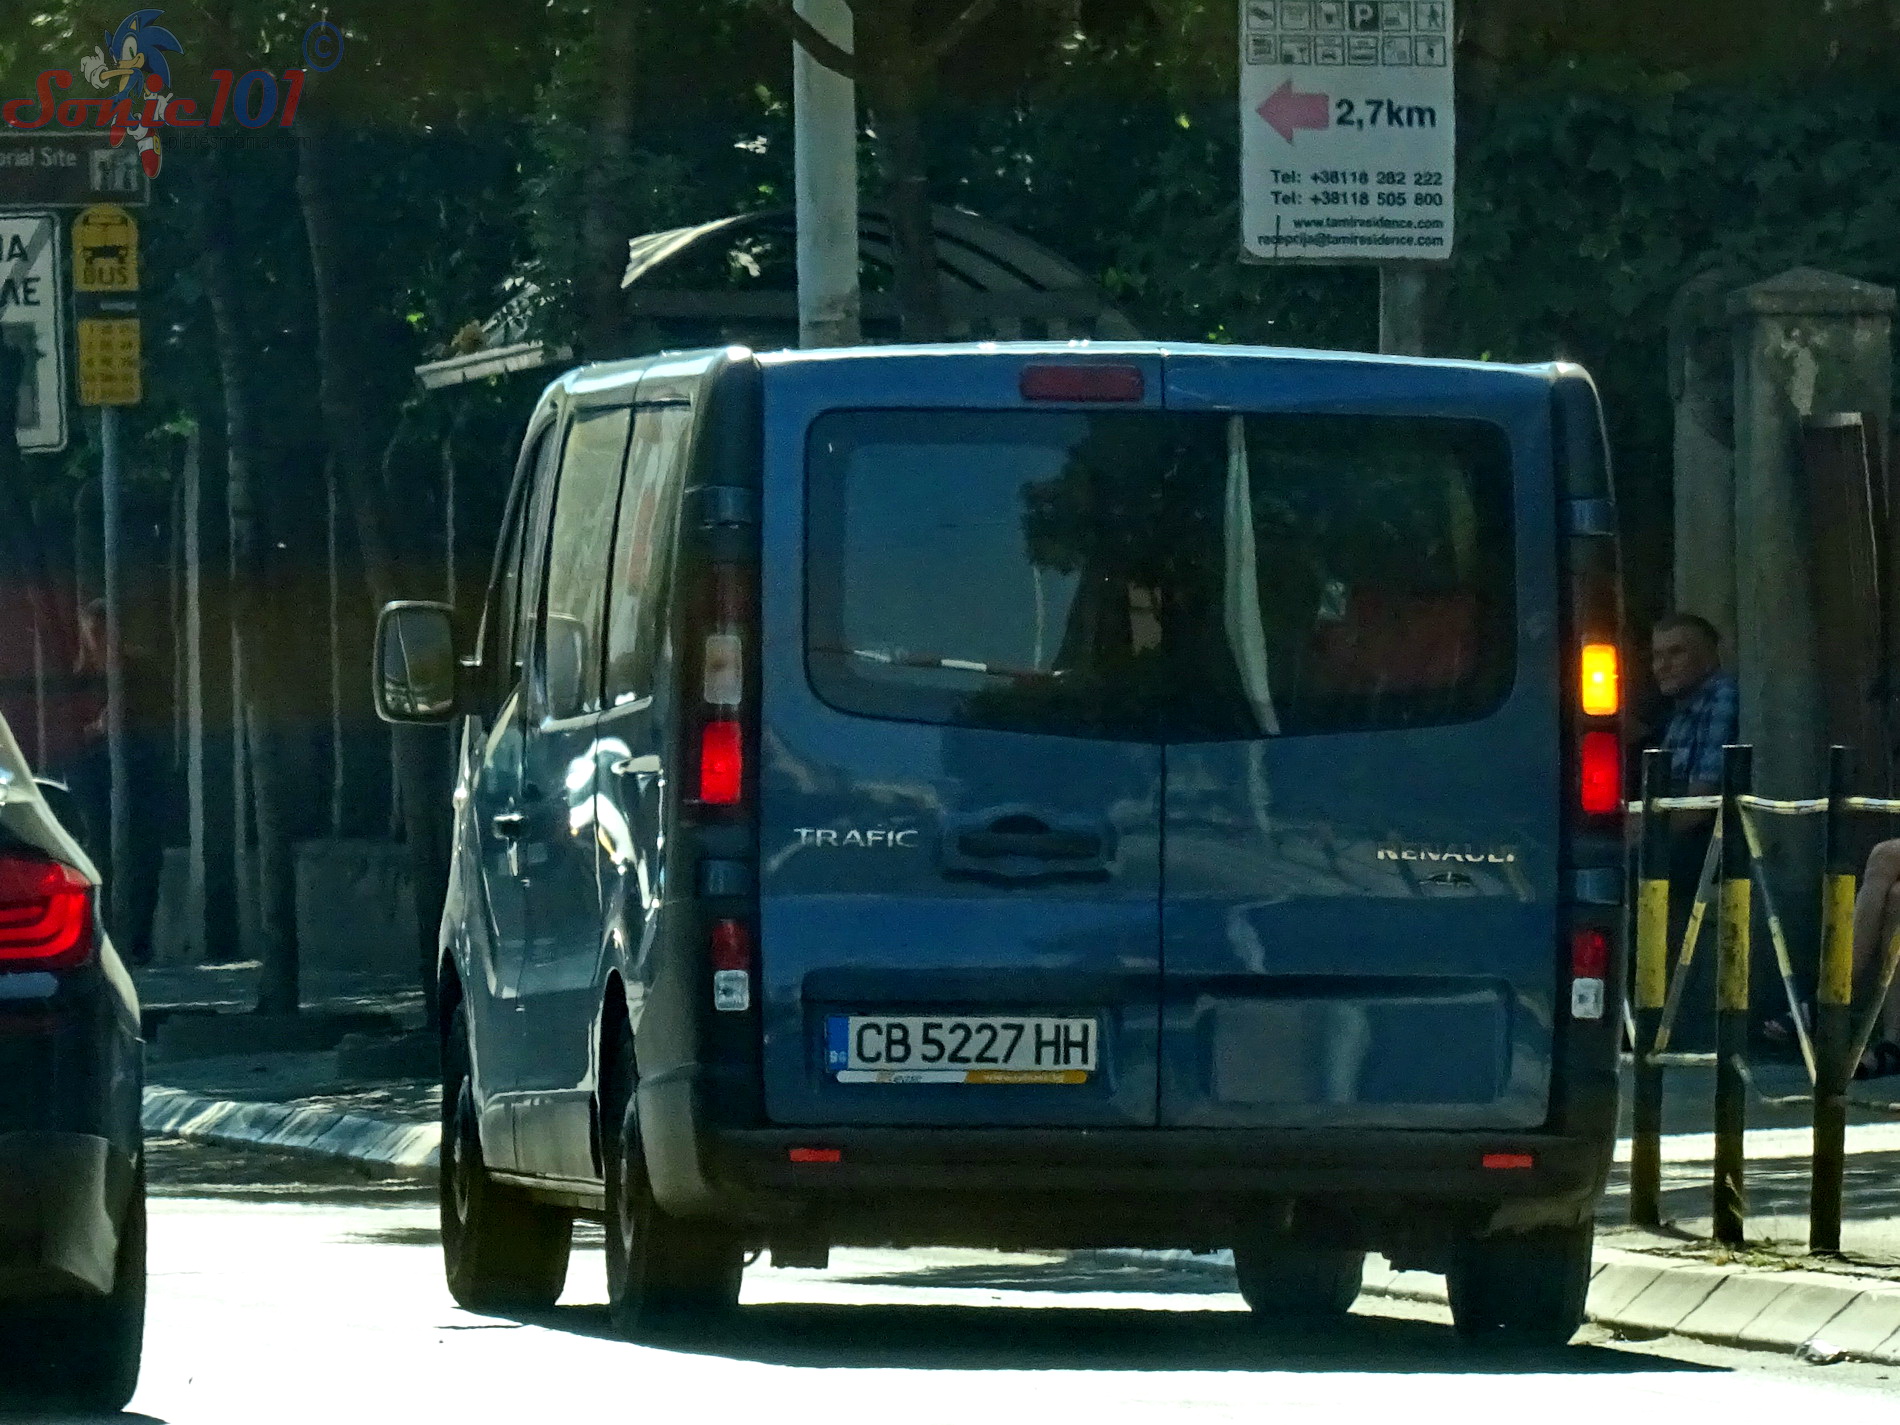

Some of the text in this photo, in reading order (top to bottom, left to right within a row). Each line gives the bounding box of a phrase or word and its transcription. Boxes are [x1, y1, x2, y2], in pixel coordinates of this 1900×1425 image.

[1335, 98, 1436, 130] 2,7km
[40, 146, 77, 167] Site
[1271, 169, 1443, 186] Tel: +38118 282 222
[1271, 191, 1303, 206] Tel:
[1311, 191, 1370, 206] +38118
[1377, 192, 1407, 206] 505
[83, 266, 128, 286] BUS
[793, 827, 919, 848] TRAFIC
[856, 1022, 1090, 1066] CB 5227 HH
